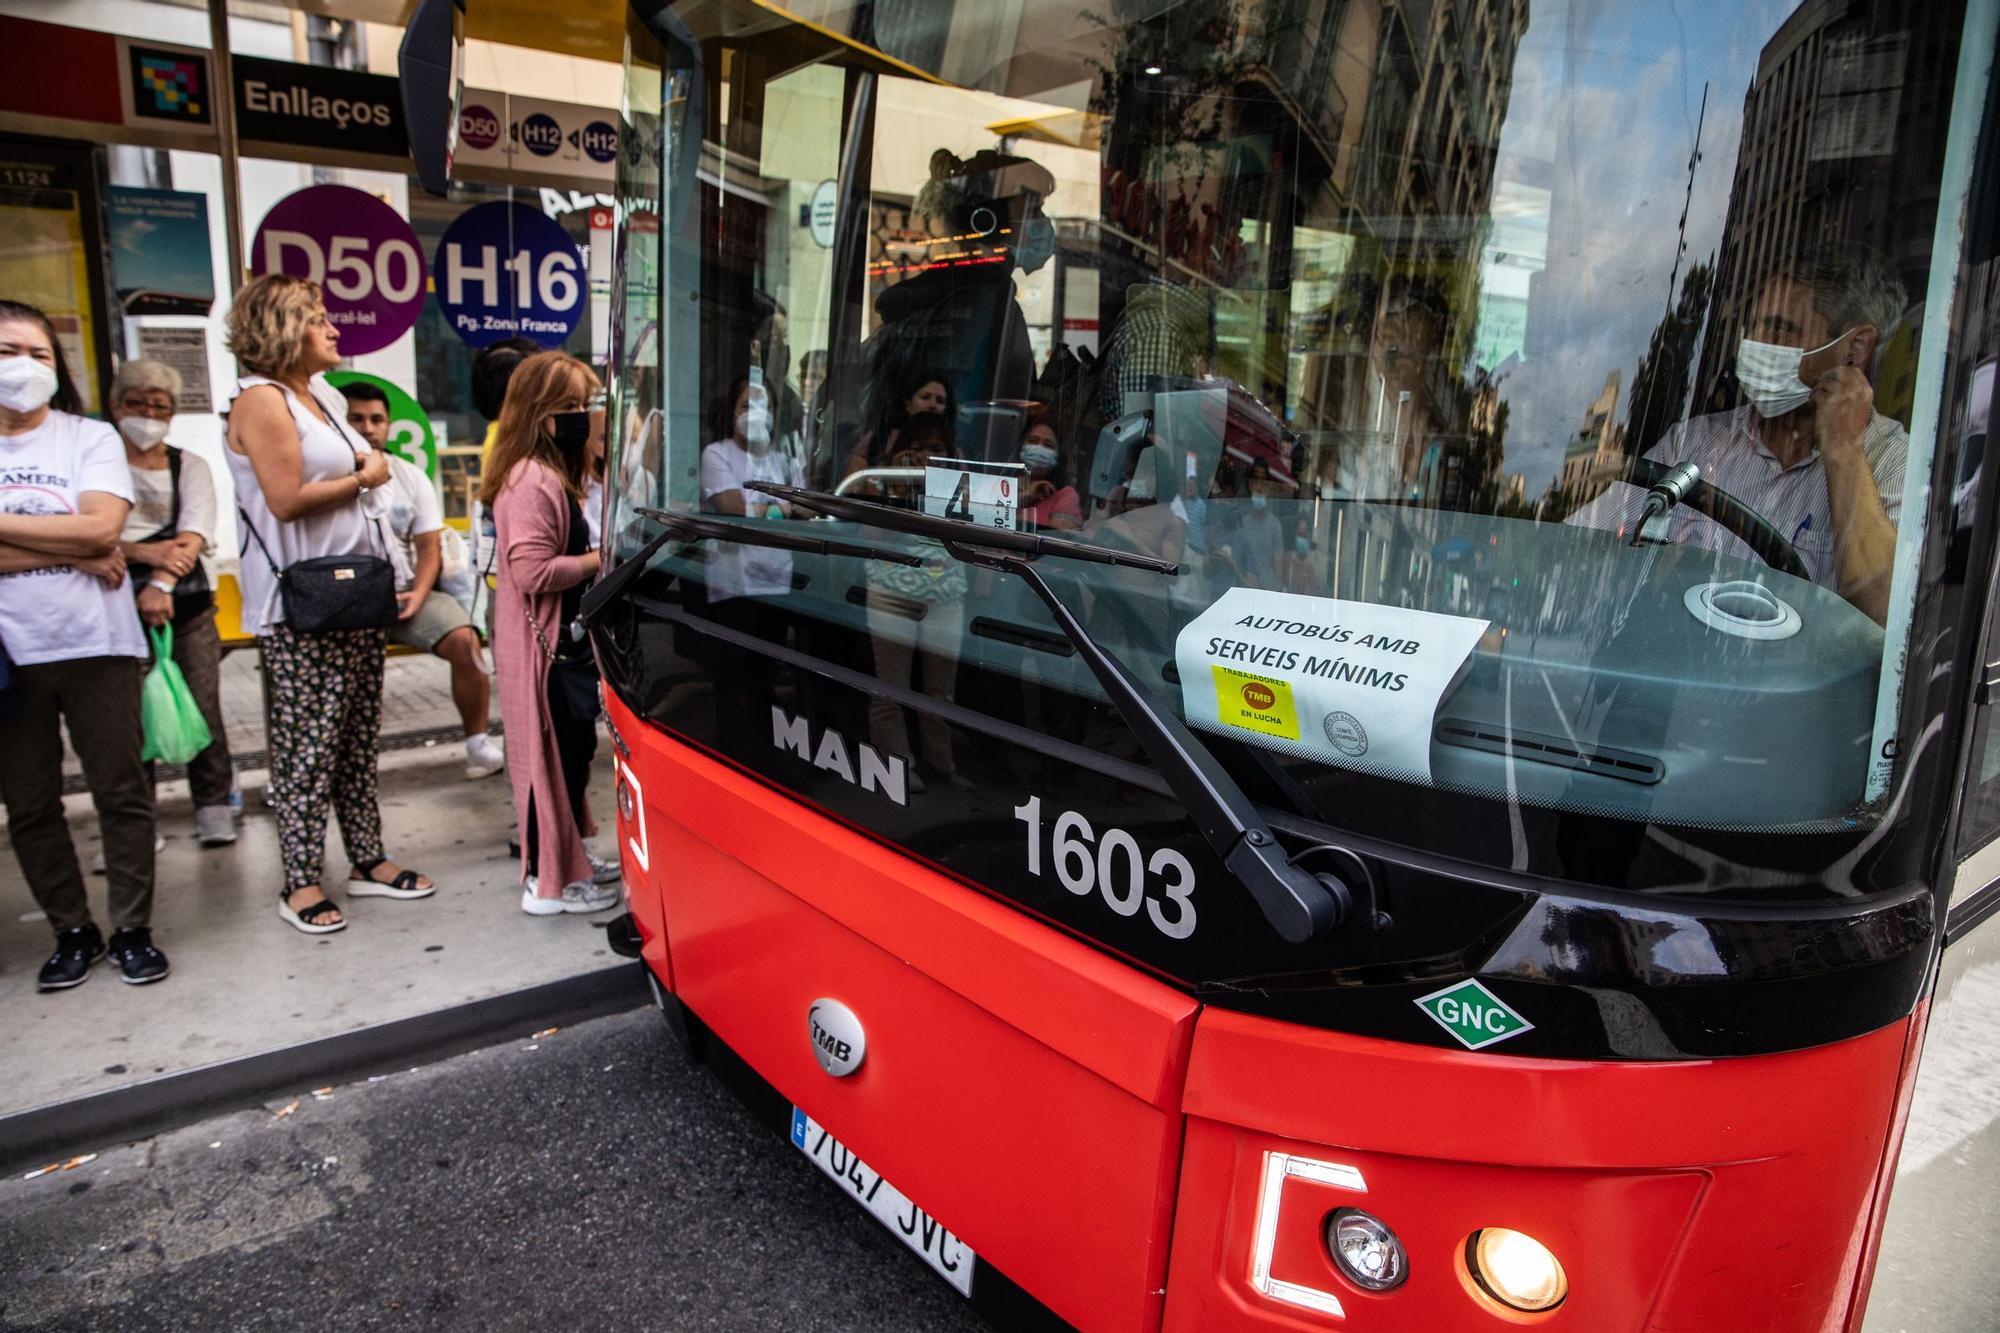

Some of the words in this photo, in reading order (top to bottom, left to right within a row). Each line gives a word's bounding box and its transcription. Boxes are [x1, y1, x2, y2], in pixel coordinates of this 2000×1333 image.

[244, 79, 392, 130] Enllaços
[461, 117, 498, 138] D50
[525, 124, 560, 144] H12
[264, 229, 421, 304] D50
[447, 242, 579, 312] H16
[457, 315, 482, 331] Pg.
[483, 316, 519, 331] Zona
[521, 318, 568, 334] Franca
[1236, 614, 1354, 644] AUTOBÚS
[1354, 633, 1421, 656] AMB
[1206, 637, 1300, 671] SERVEIS
[1302, 656, 1409, 692] MÍNIMS
[1222, 667, 1287, 688] TRABAJADORES
[1241, 709, 1252, 718] EN
[1254, 712, 1282, 725] LUCHA
[1247, 690, 1272, 703] TMB
[772, 704, 908, 807] MAN
[1014, 795, 1197, 940] 1603
[1437, 997, 1506, 1033] GNC
[813, 1020, 851, 1062] TMB
